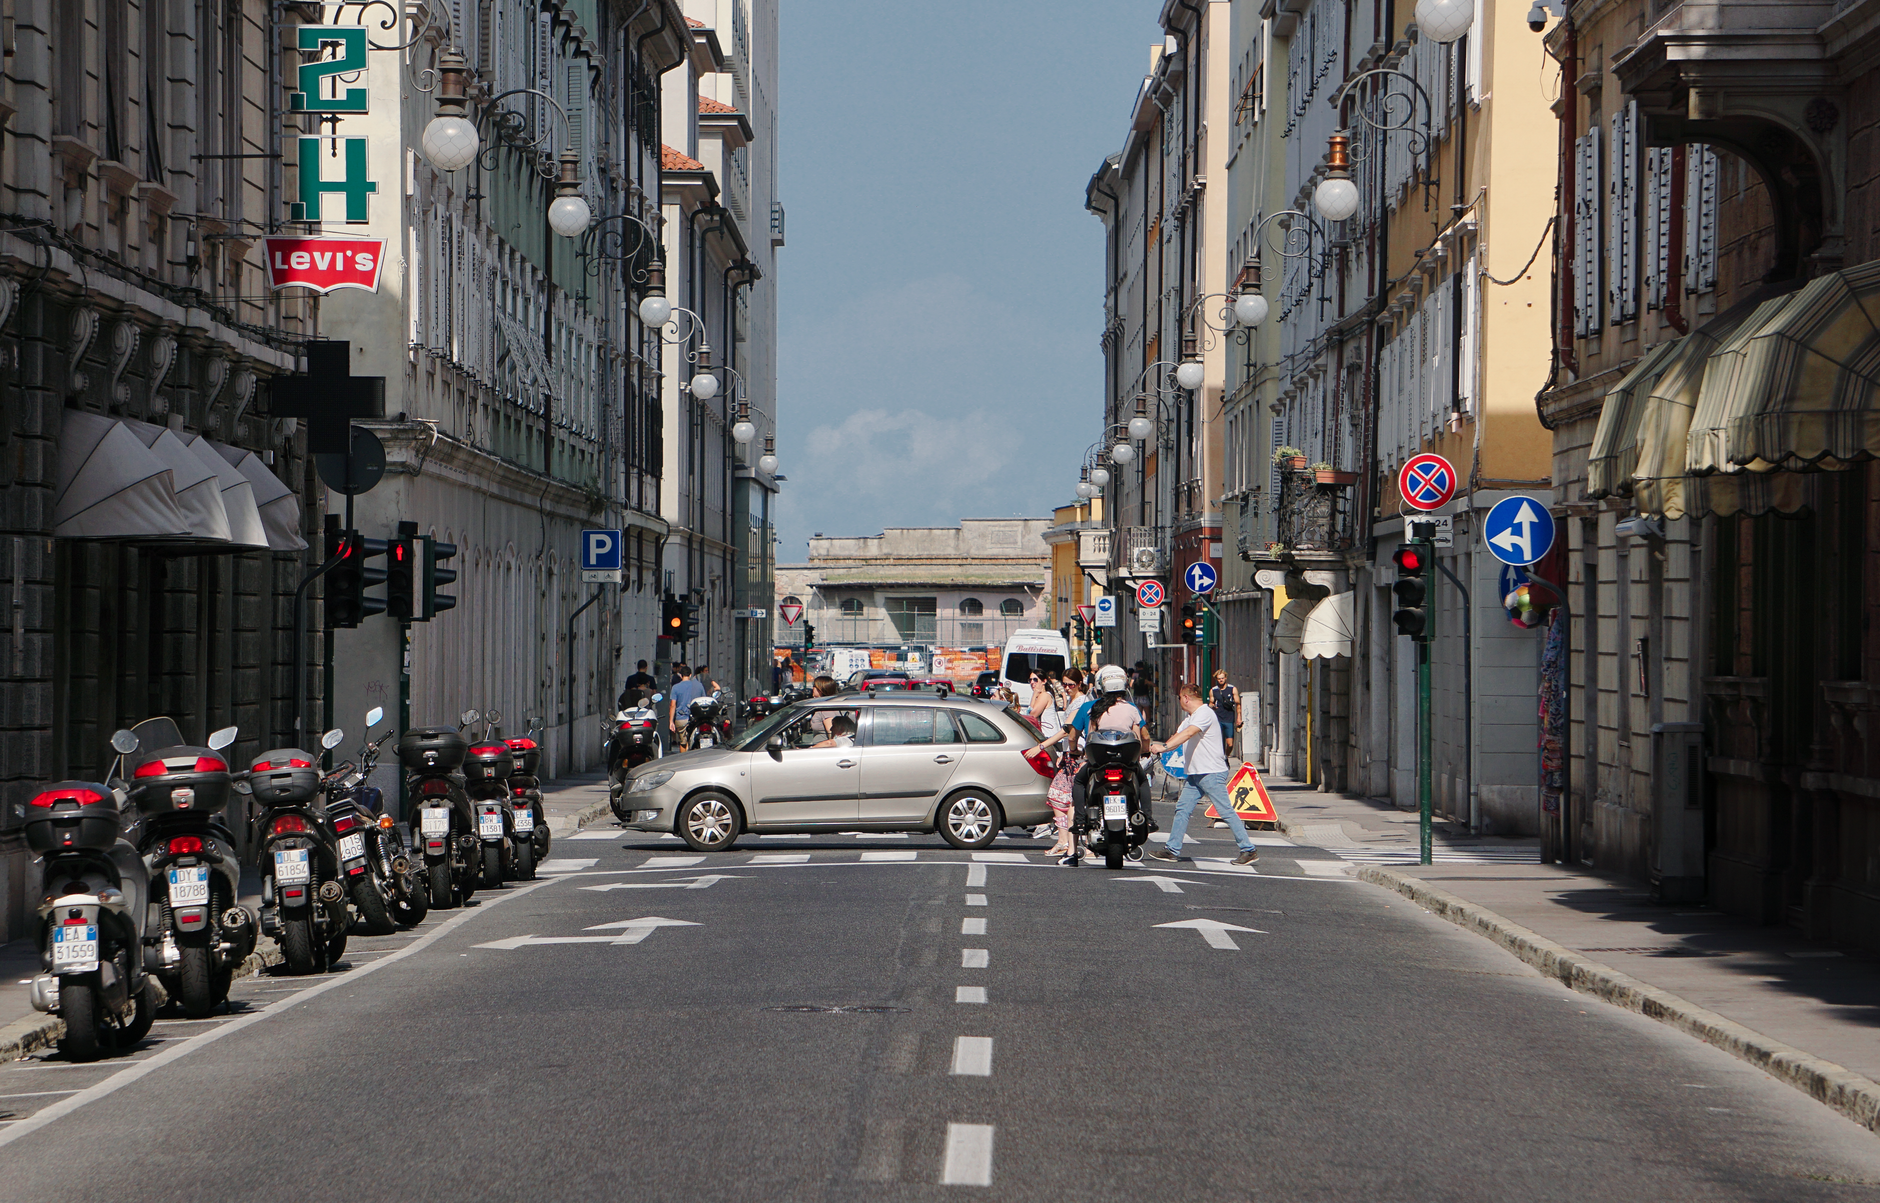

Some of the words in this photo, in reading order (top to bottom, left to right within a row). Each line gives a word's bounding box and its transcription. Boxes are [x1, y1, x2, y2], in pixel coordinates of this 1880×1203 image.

[589, 533, 613, 566] P
[1105, 804, 1126, 814] 96015
[485, 815, 494, 824] BW
[481, 824, 501, 833] 11381
[283, 851, 295, 862] DL
[178, 869, 192, 882] DY
[278, 864, 307, 877] 61854
[173, 884, 206, 899] 18788
[65, 927, 80, 941] EA
[56, 943, 95, 960] 31559
